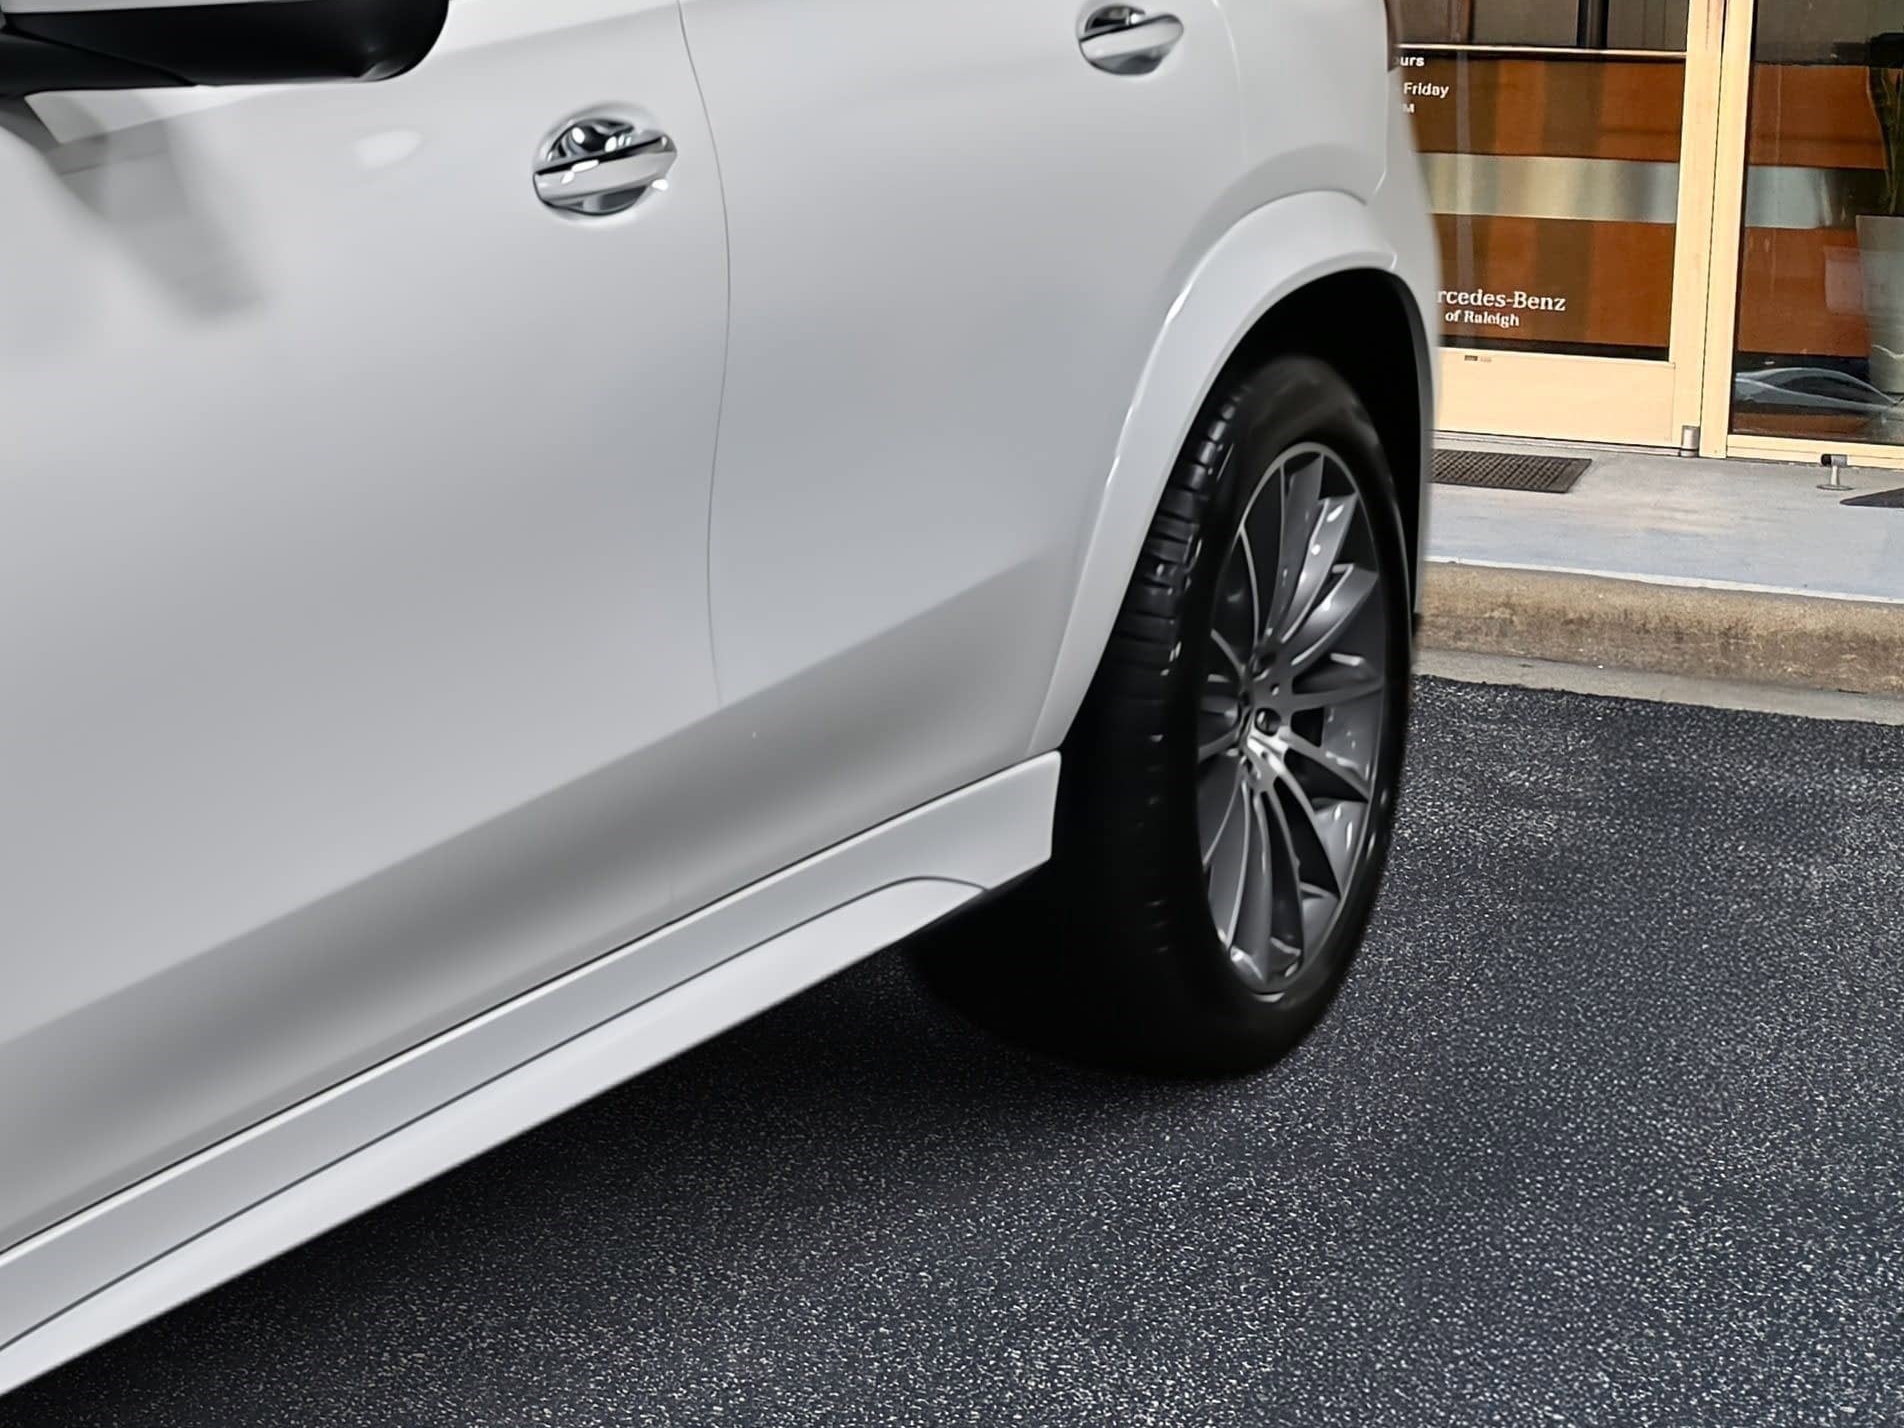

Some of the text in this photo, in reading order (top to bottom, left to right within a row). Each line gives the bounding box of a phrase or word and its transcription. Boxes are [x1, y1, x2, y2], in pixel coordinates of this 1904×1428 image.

[1403, 82, 1450, 98] Friday
[1436, 289, 1566, 311] rcedes-Benz
[1445, 310, 1520, 328] of Raleigh
